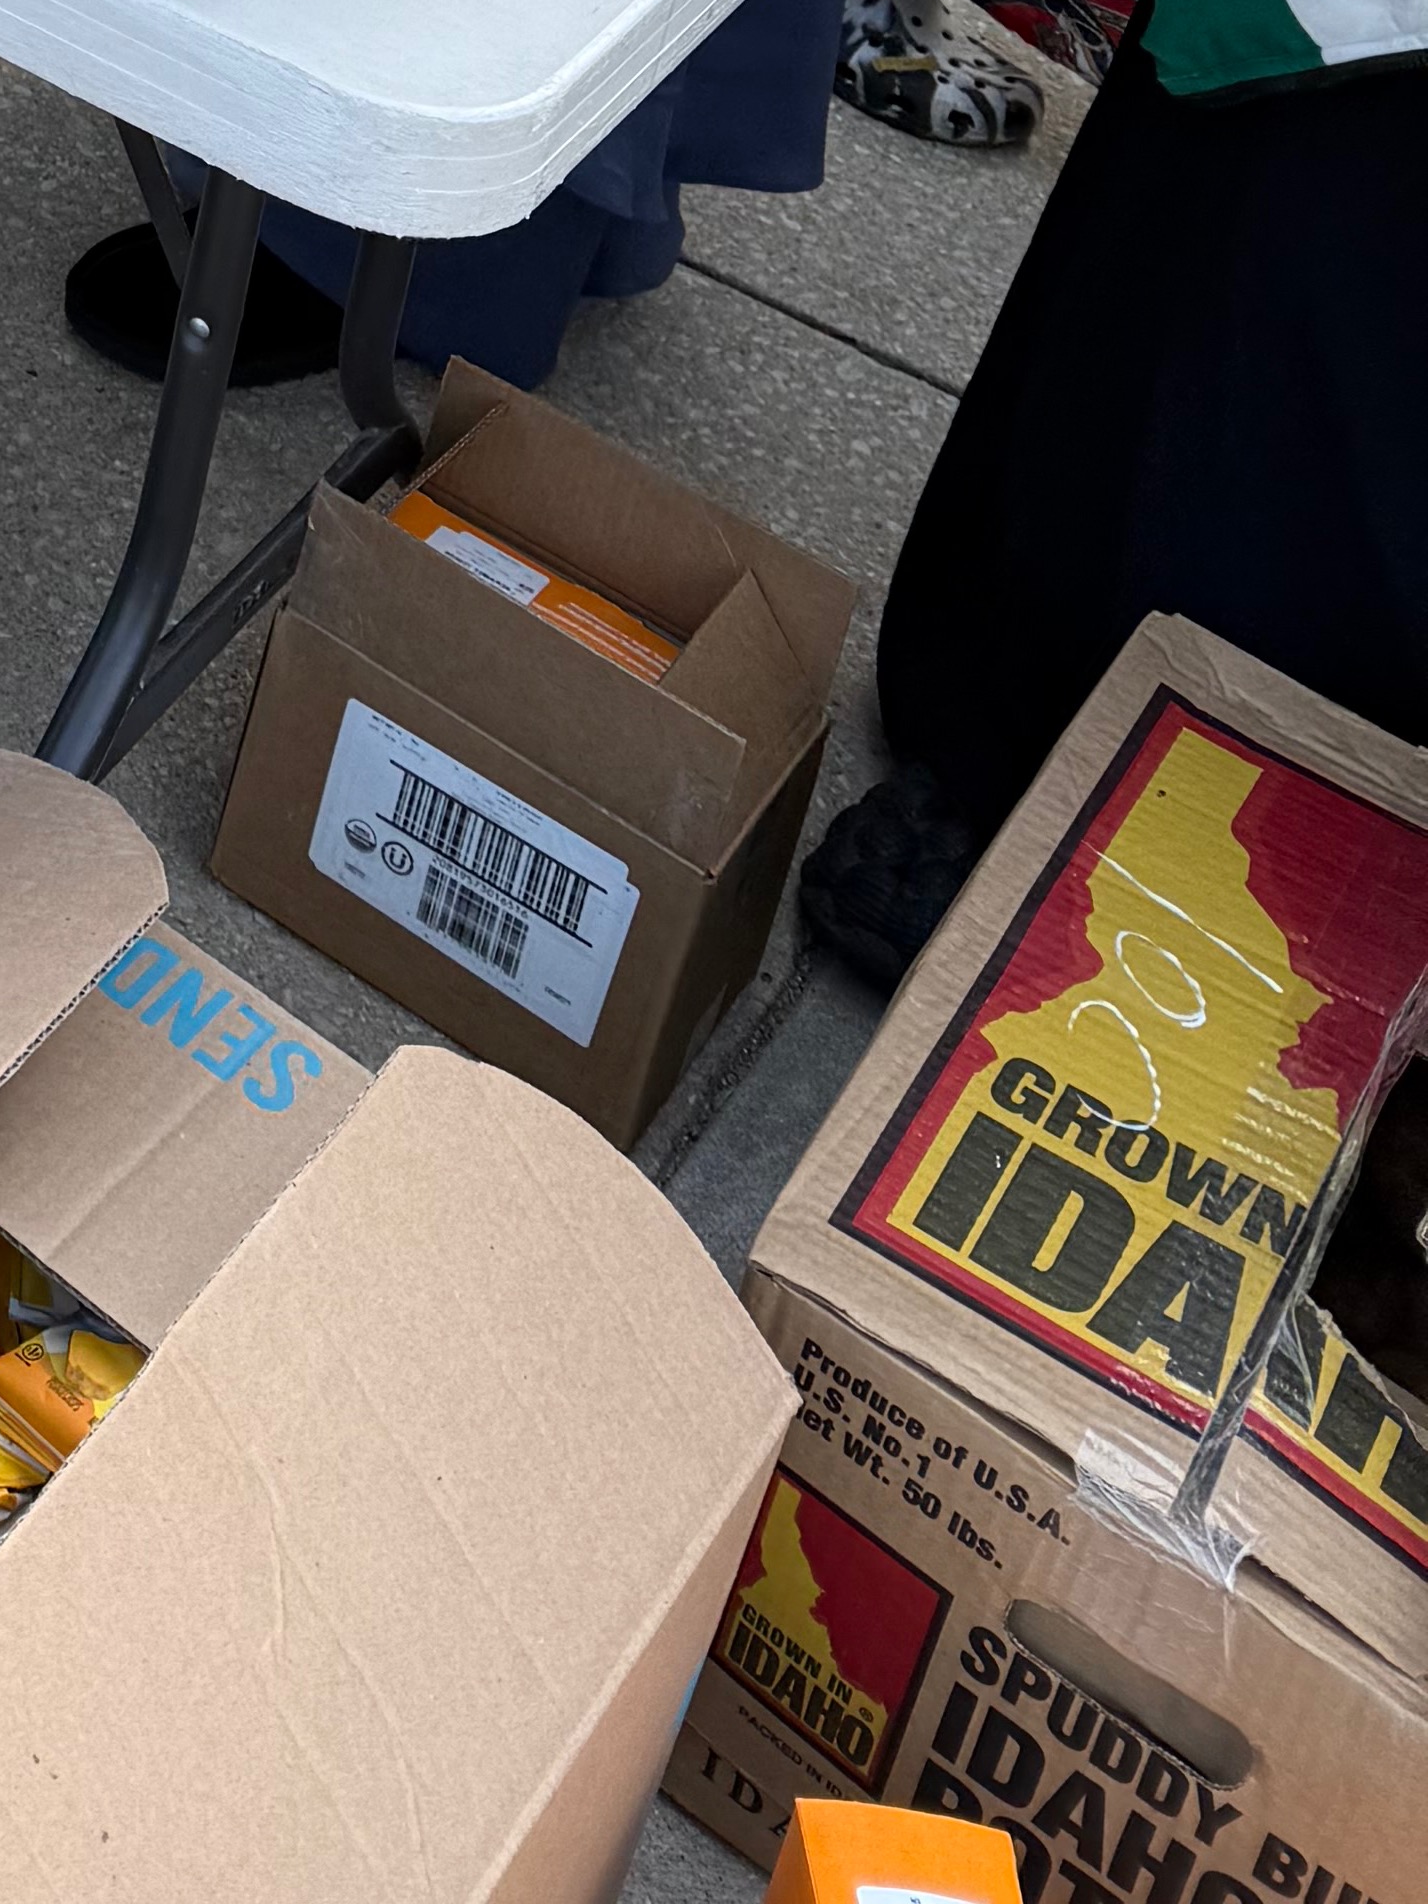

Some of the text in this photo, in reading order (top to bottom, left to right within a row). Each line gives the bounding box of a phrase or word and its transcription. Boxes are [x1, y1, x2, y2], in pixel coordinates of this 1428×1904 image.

[98, 935, 325, 1113] SEND
[989, 1056, 1307, 1258] GROWN
[800, 1337, 1071, 1547] Produce of U.S.A.
[843, 1440, 891, 1486] Wt.
[902, 1481, 942, 1521] 50
[947, 1510, 1004, 1571] lbs.
[729, 1621, 875, 1768] IDAHO
[740, 1603, 854, 1705] GROWN IN
[737, 1704, 823, 1780] PACKED IN
[960, 1625, 1245, 1848] SPUDDY
